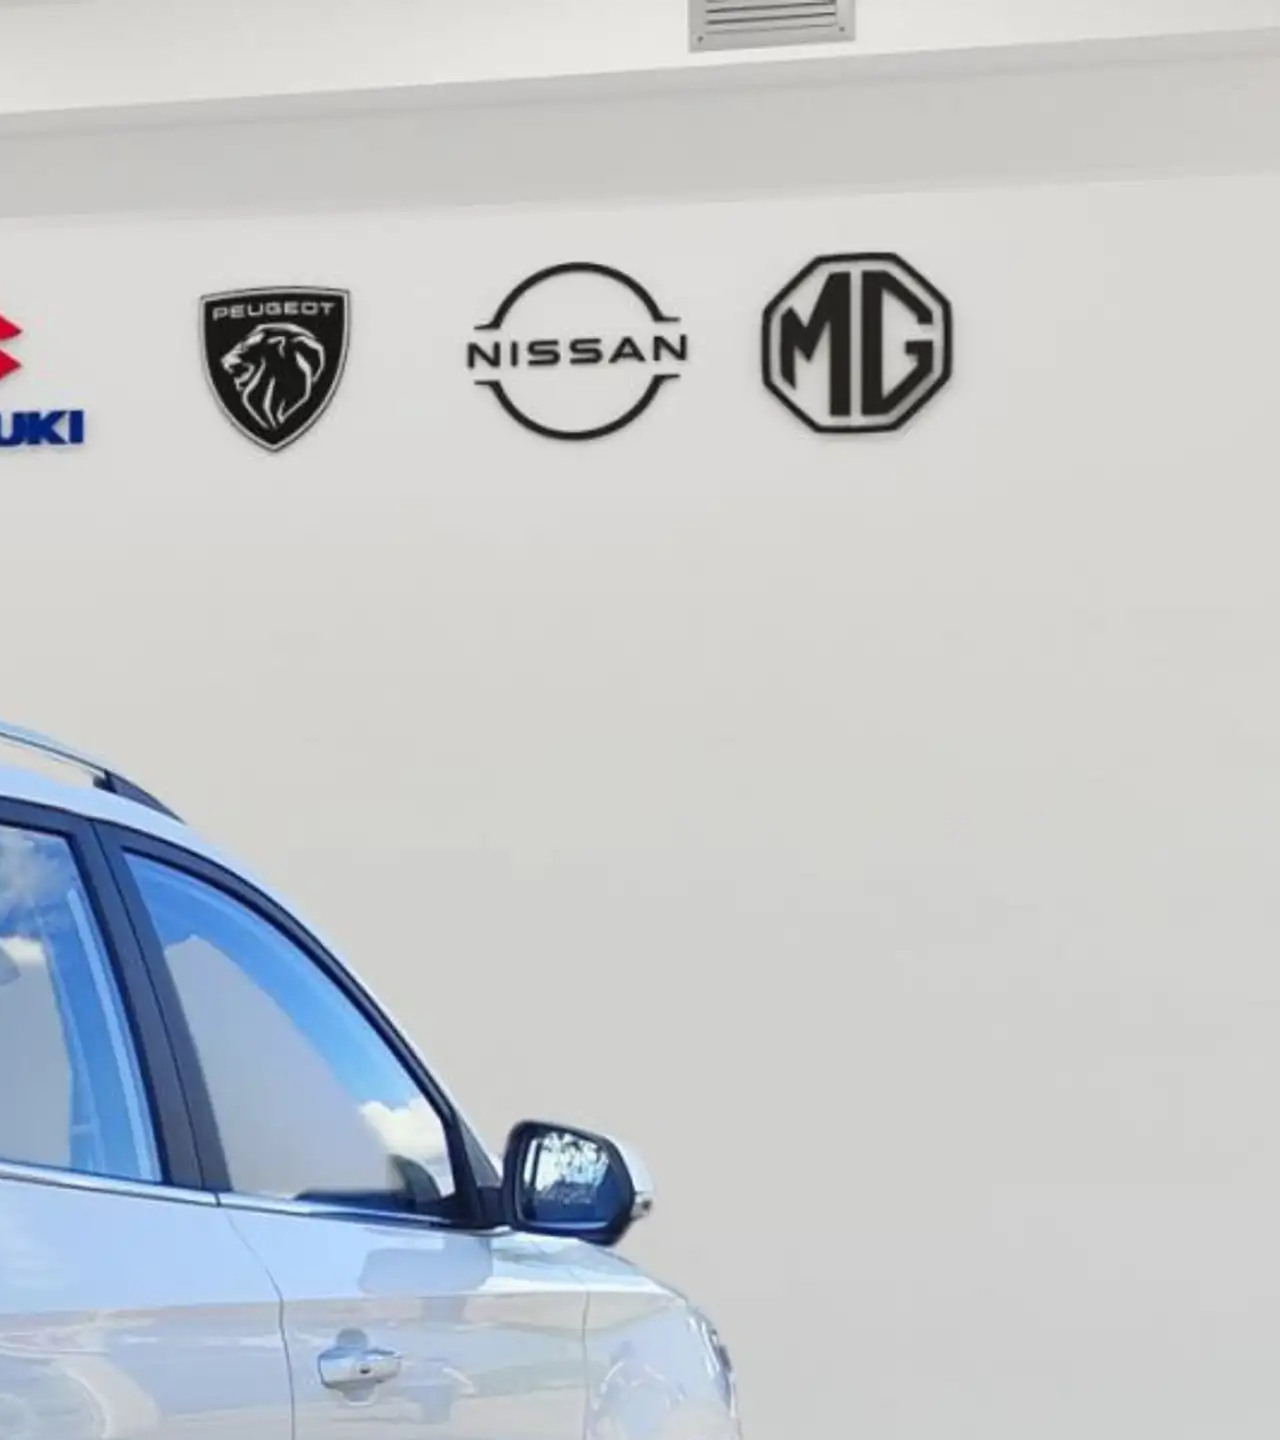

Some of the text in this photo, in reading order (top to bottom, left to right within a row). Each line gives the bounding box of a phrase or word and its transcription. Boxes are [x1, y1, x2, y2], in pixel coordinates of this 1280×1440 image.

[212, 300, 336, 321] PEUGEOT
[467, 333, 689, 370] NISSAN
[778, 269, 935, 418] MG
